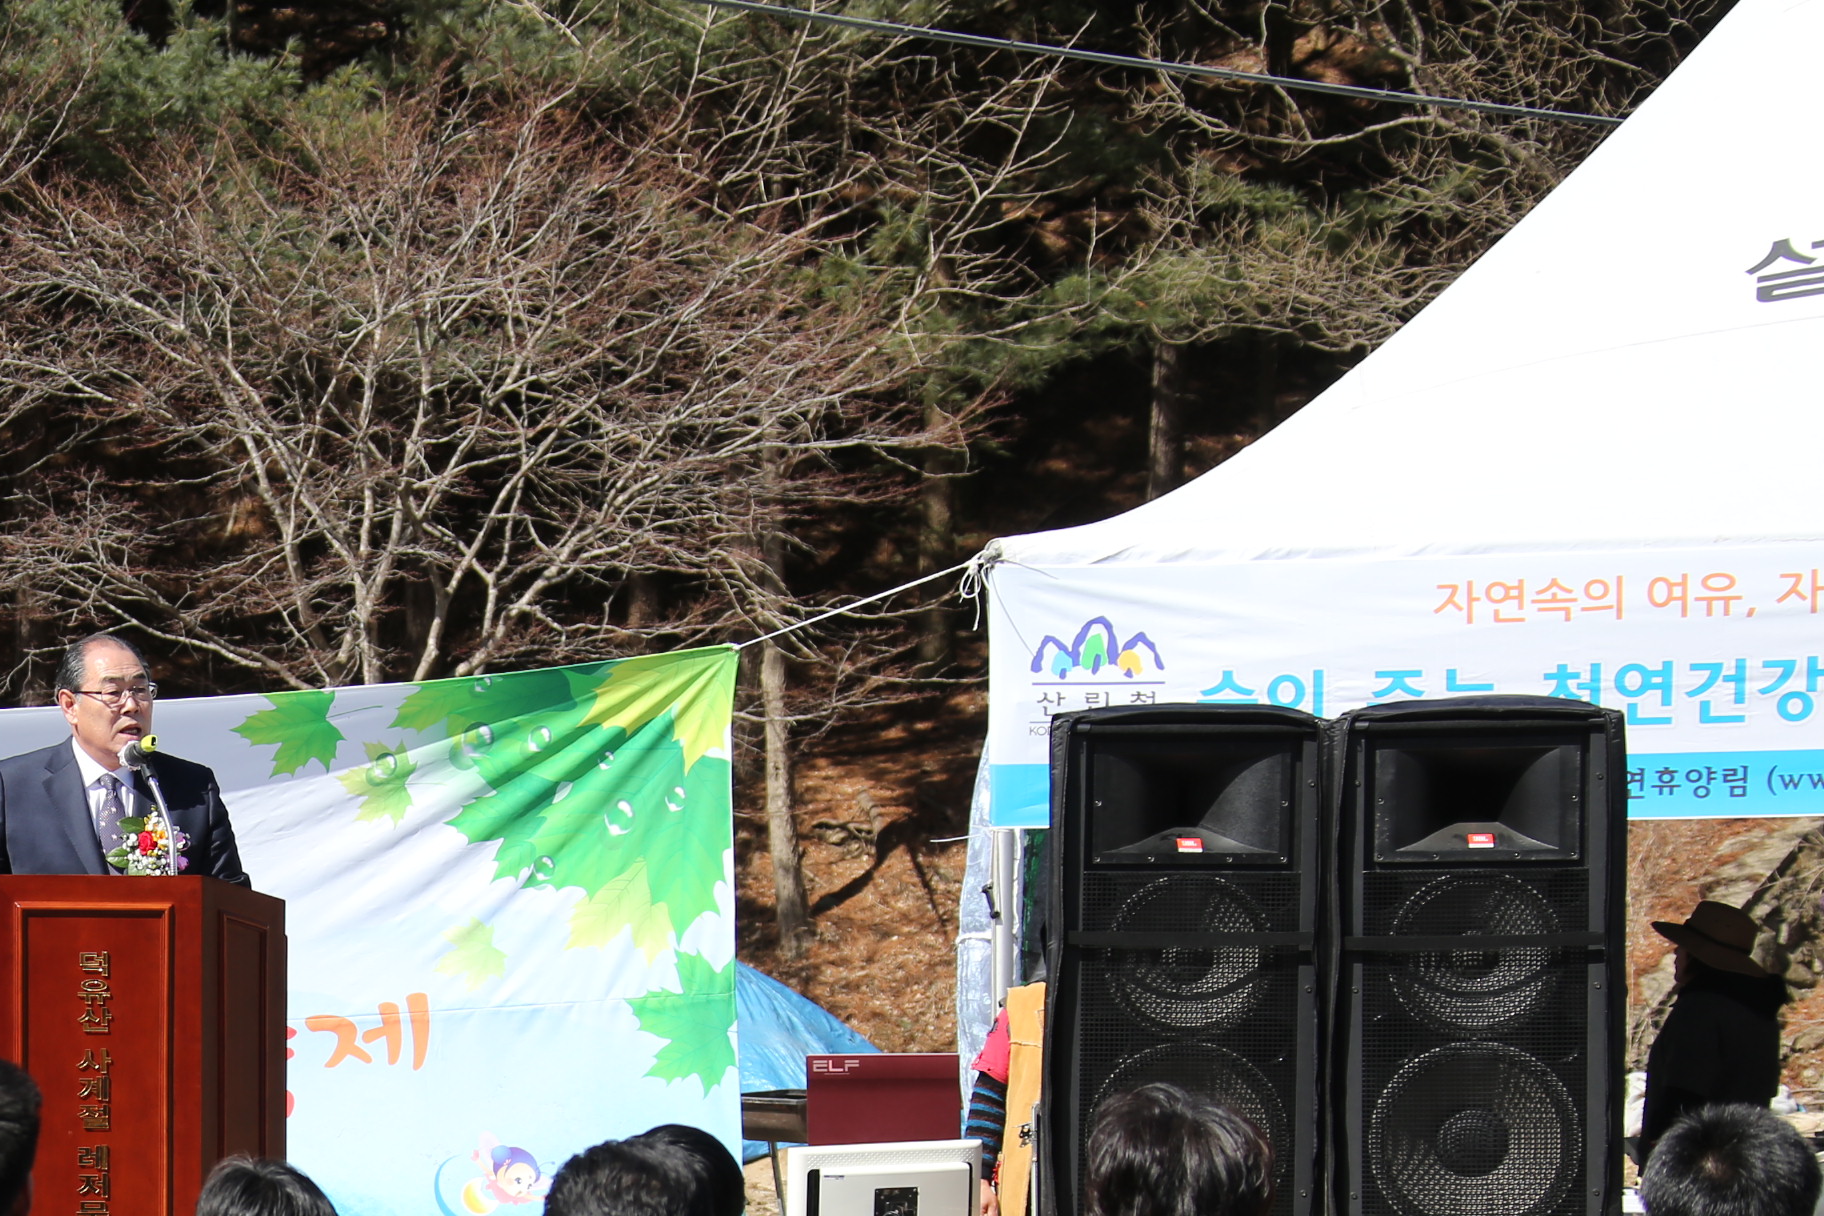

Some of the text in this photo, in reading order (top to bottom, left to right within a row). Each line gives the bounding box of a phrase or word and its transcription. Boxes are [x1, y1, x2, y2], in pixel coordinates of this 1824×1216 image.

[1433, 575, 1624, 624] 자연속의
[1647, 571, 1757, 618] 여유,
[76, 950, 112, 1033] 덕유산
[76, 1047, 112, 1131] 사계절
[812, 1059, 860, 1073] ELF
